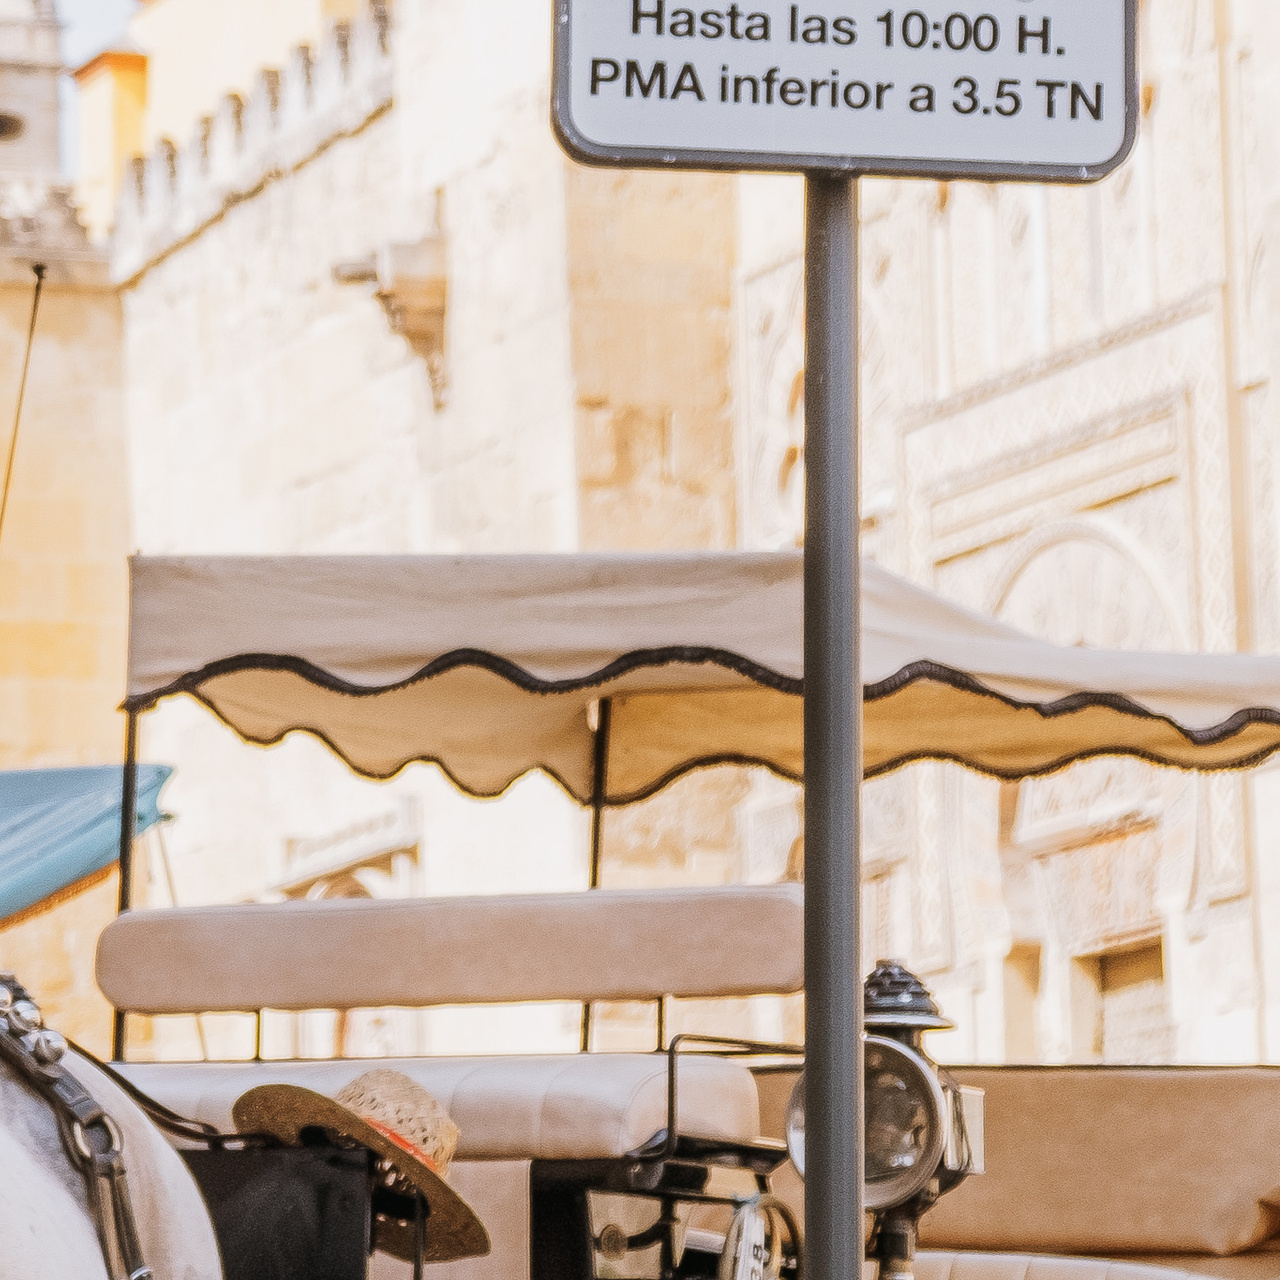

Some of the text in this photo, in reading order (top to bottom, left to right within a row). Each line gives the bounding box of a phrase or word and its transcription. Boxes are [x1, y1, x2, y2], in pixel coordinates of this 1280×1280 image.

[789, 4, 857, 46] las
[876, 9, 999, 53] 10:00
[1017, 14, 1066, 56] H.
[590, 57, 1104, 121] PMA inferior a 3.5 TN
